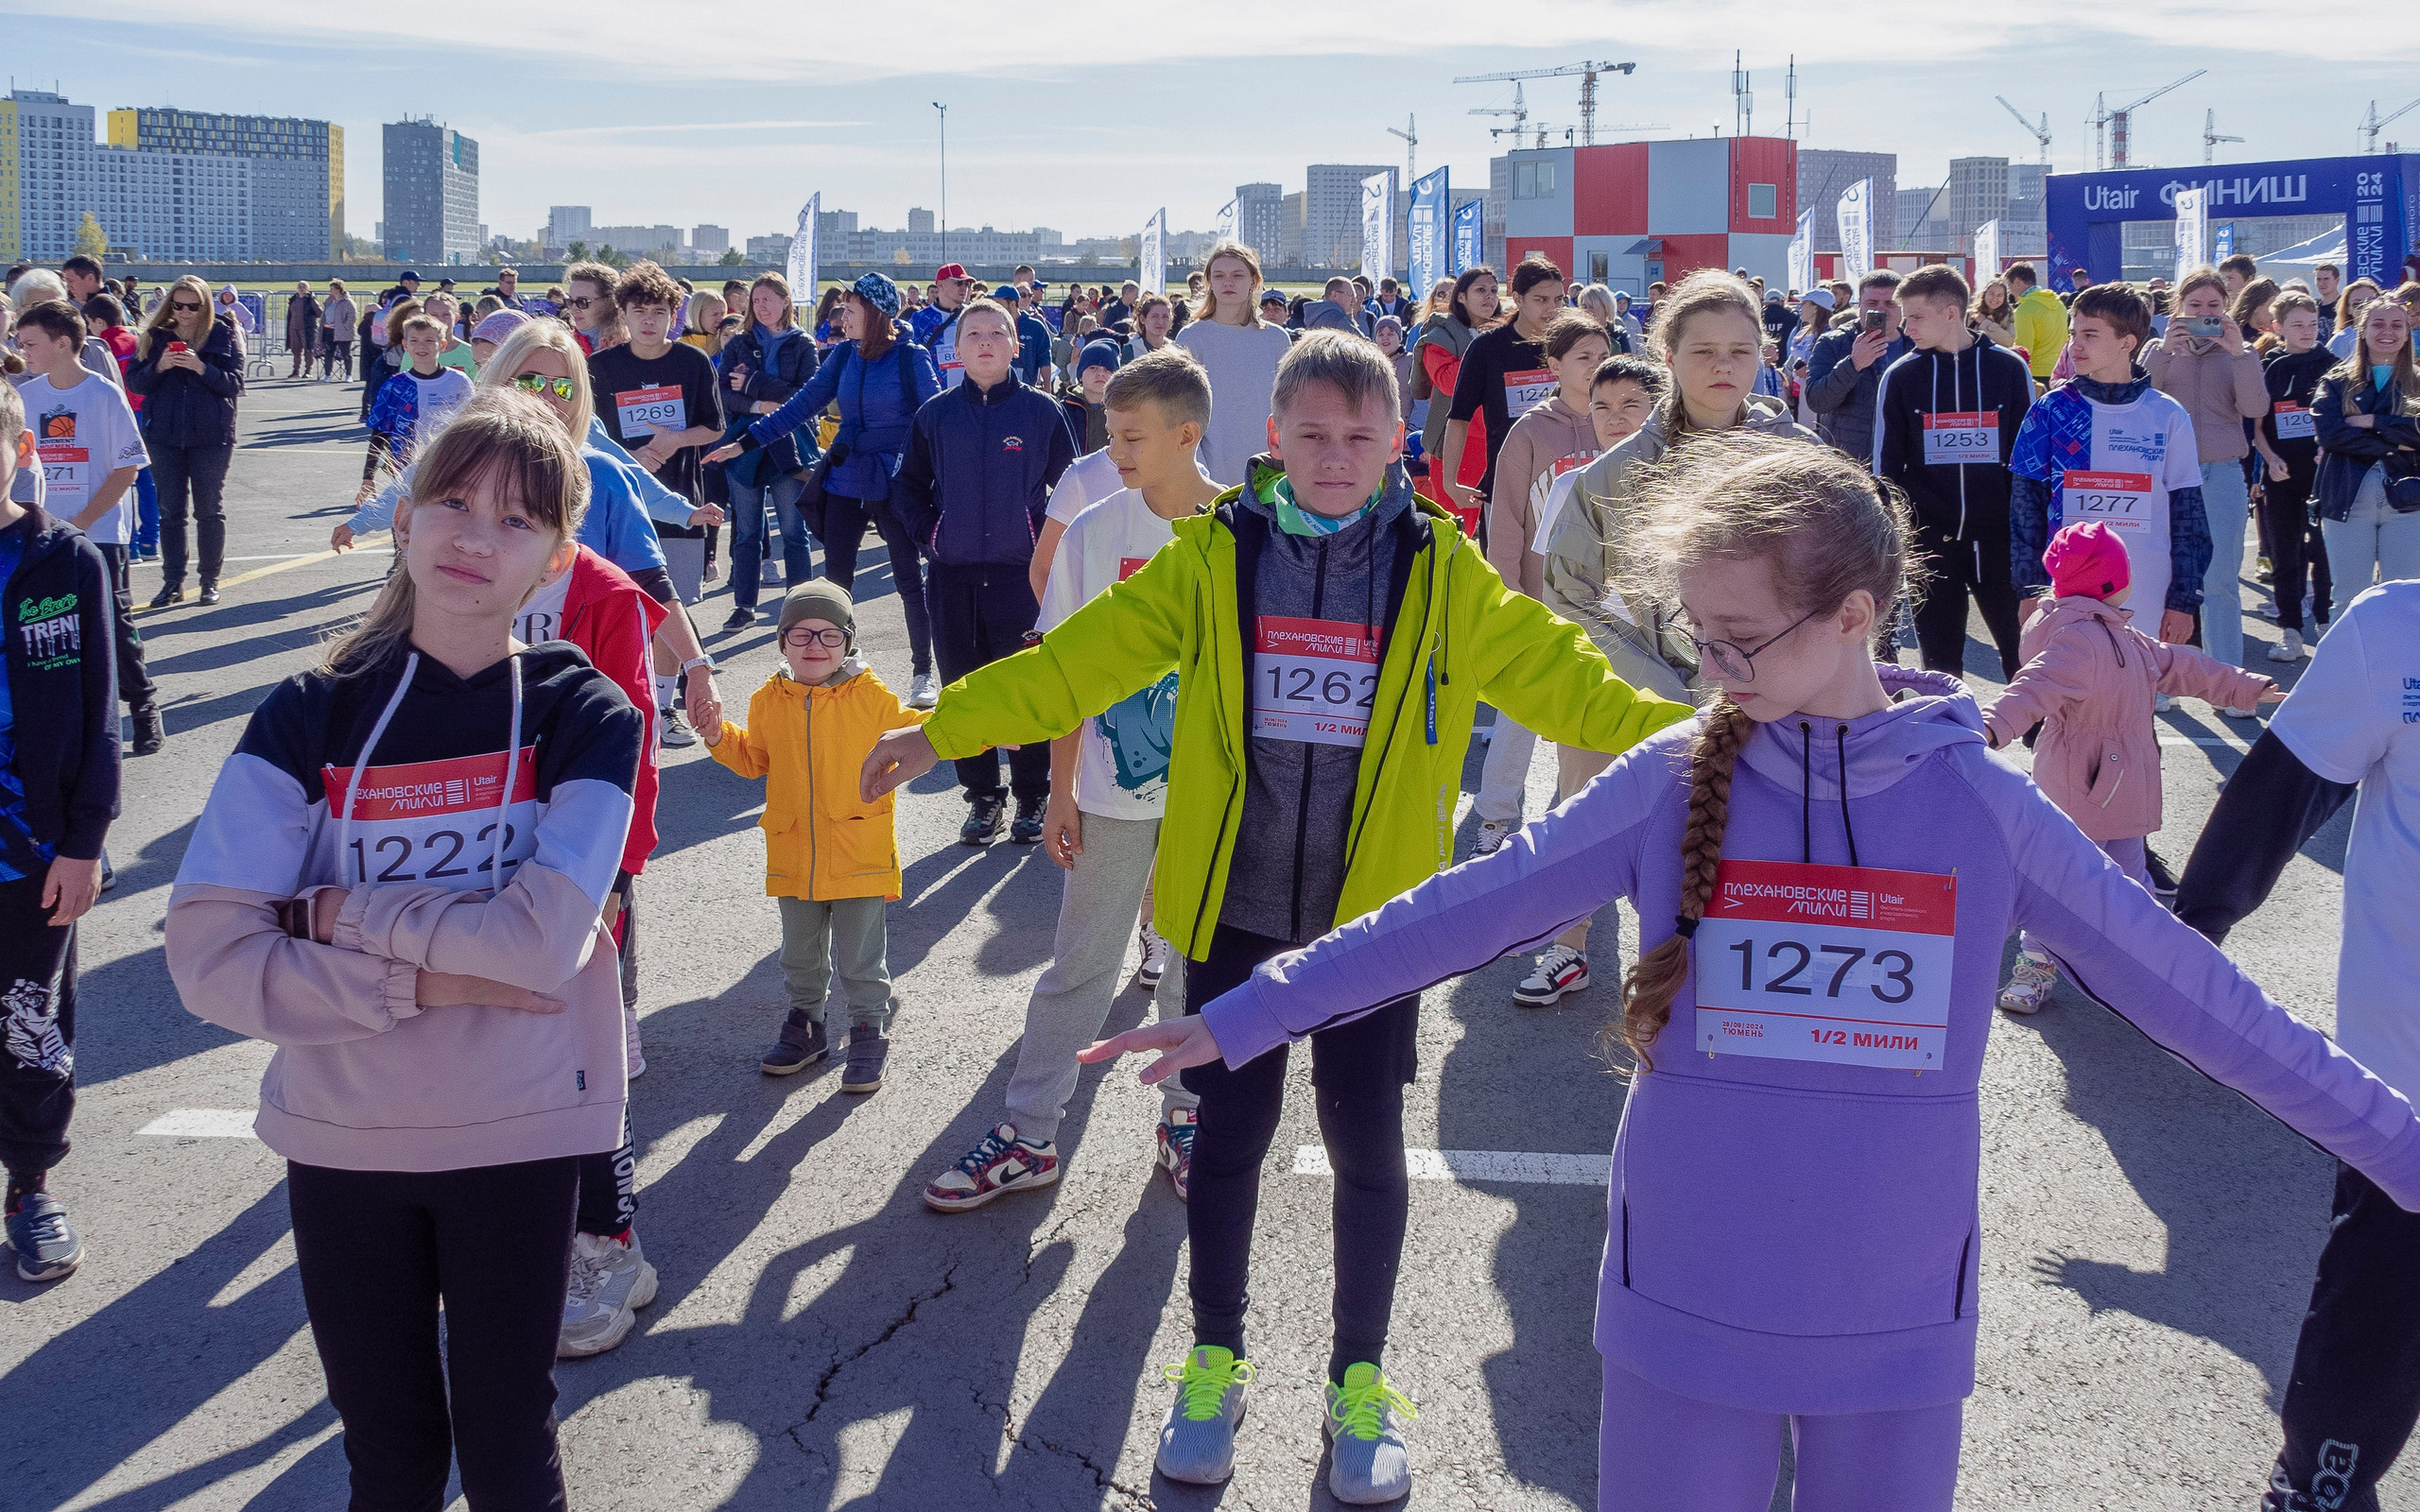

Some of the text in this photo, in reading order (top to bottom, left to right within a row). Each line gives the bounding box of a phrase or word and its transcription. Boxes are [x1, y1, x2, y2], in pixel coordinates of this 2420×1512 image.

[2159, 174, 2307, 208] ФИНИШ
[2370, 171, 2382, 196] 24
[2083, 185, 2140, 211] Utair
[2357, 172, 2369, 277] ВСКИЕ 20
[1517, 387, 1549, 403] 124
[627, 404, 676, 422] 1269
[2282, 414, 2313, 426] 120
[1933, 433, 1988, 447] 1253
[43, 466, 74, 480] 271
[2076, 494, 2138, 513] 1277
[1268, 630, 1343, 645] ПЛЕХАНОВСКИЕ
[1305, 643, 1342, 654] МИЛИ
[1267, 666, 1377, 709] 1262
[1314, 722, 1368, 736] 1/2 МИЛ
[346, 775, 497, 799] ЕХАНОВСКИЕ Utair
[389, 796, 444, 811] МИЛИ
[350, 822, 519, 883] 1222
[1724, 882, 1905, 904] ПЛЕХАНОВСКИЕ Utair
[1788, 901, 1847, 917] МИЛИ
[1730, 938, 1914, 1004] 1273
[1722, 1027, 1764, 1038] ТЮМЕНЬ
[1811, 1029, 1918, 1050] 1/2 МИЛИ
